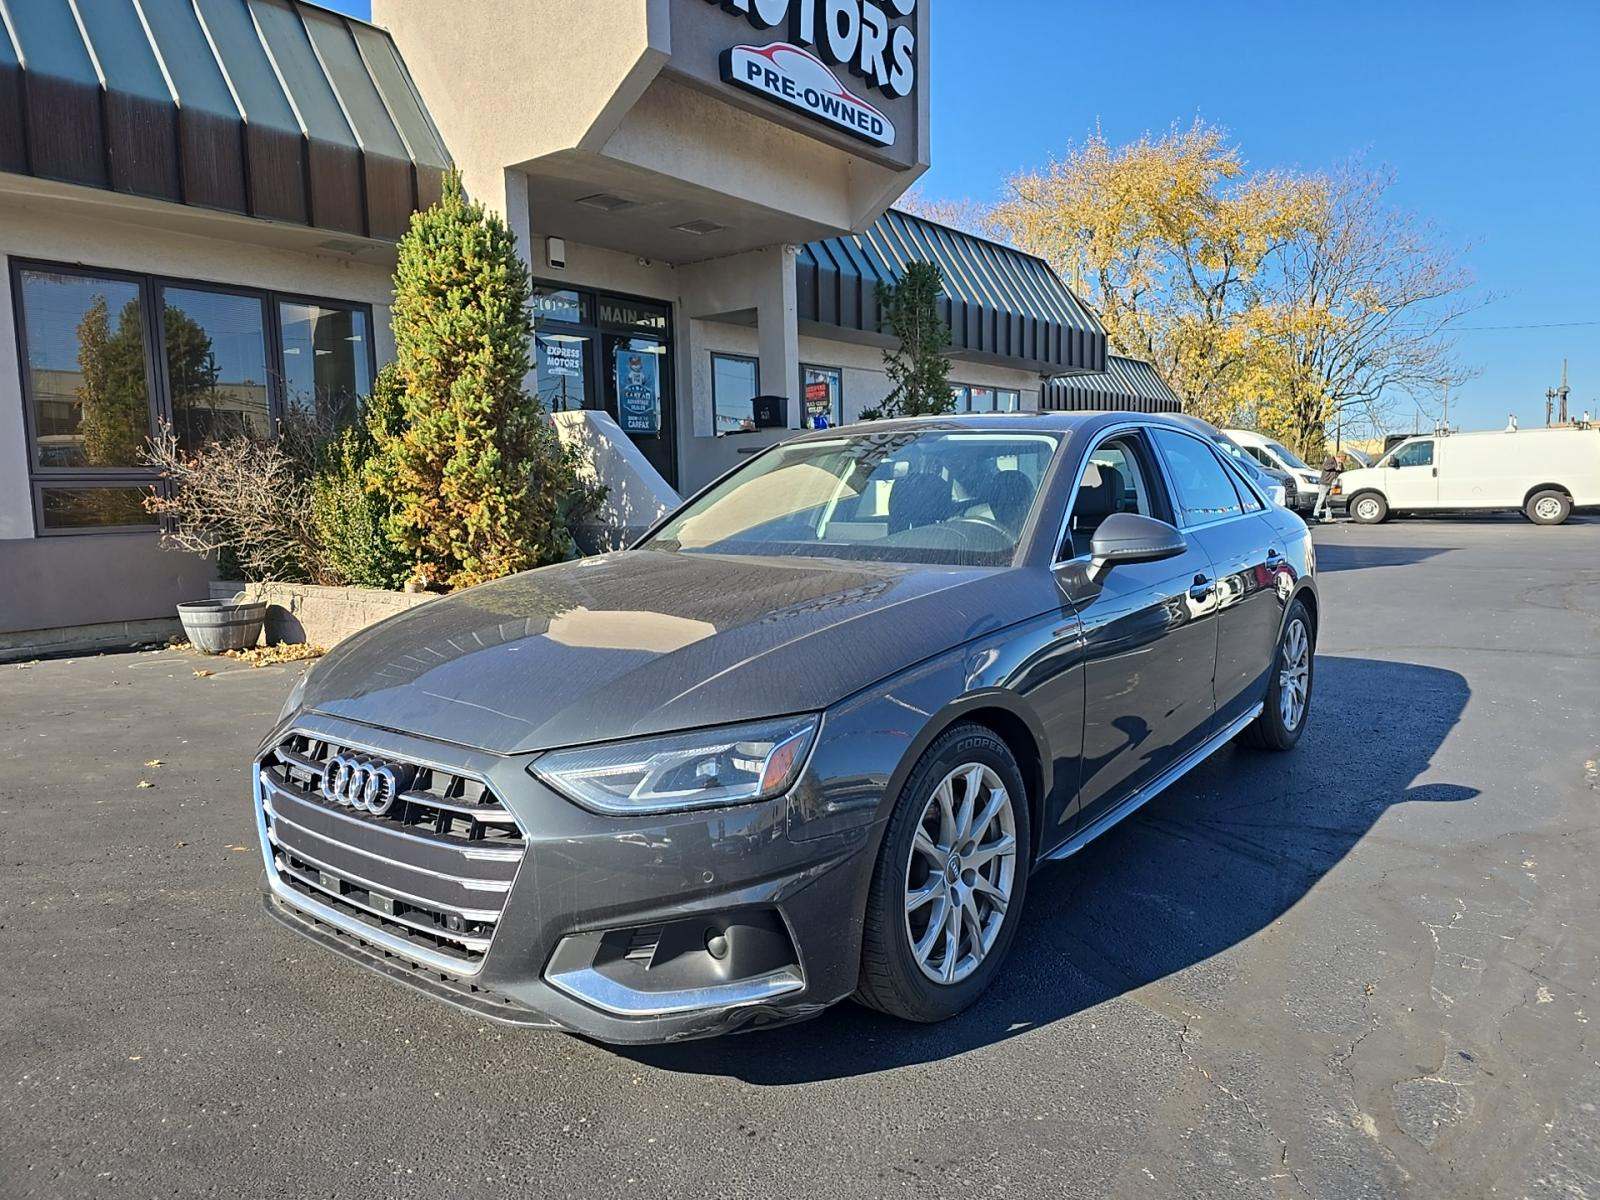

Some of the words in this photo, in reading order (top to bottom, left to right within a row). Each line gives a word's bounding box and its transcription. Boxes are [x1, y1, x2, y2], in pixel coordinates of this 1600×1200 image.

[732, 0, 914, 97] ORS
[746, 60, 884, 136] PRE-OWNED
[600, 305, 637, 324] MAIN
[547, 346, 580, 358] EXPRESS
[547, 357, 580, 368] MOTORS
[957, 738, 1005, 756] COOPER
